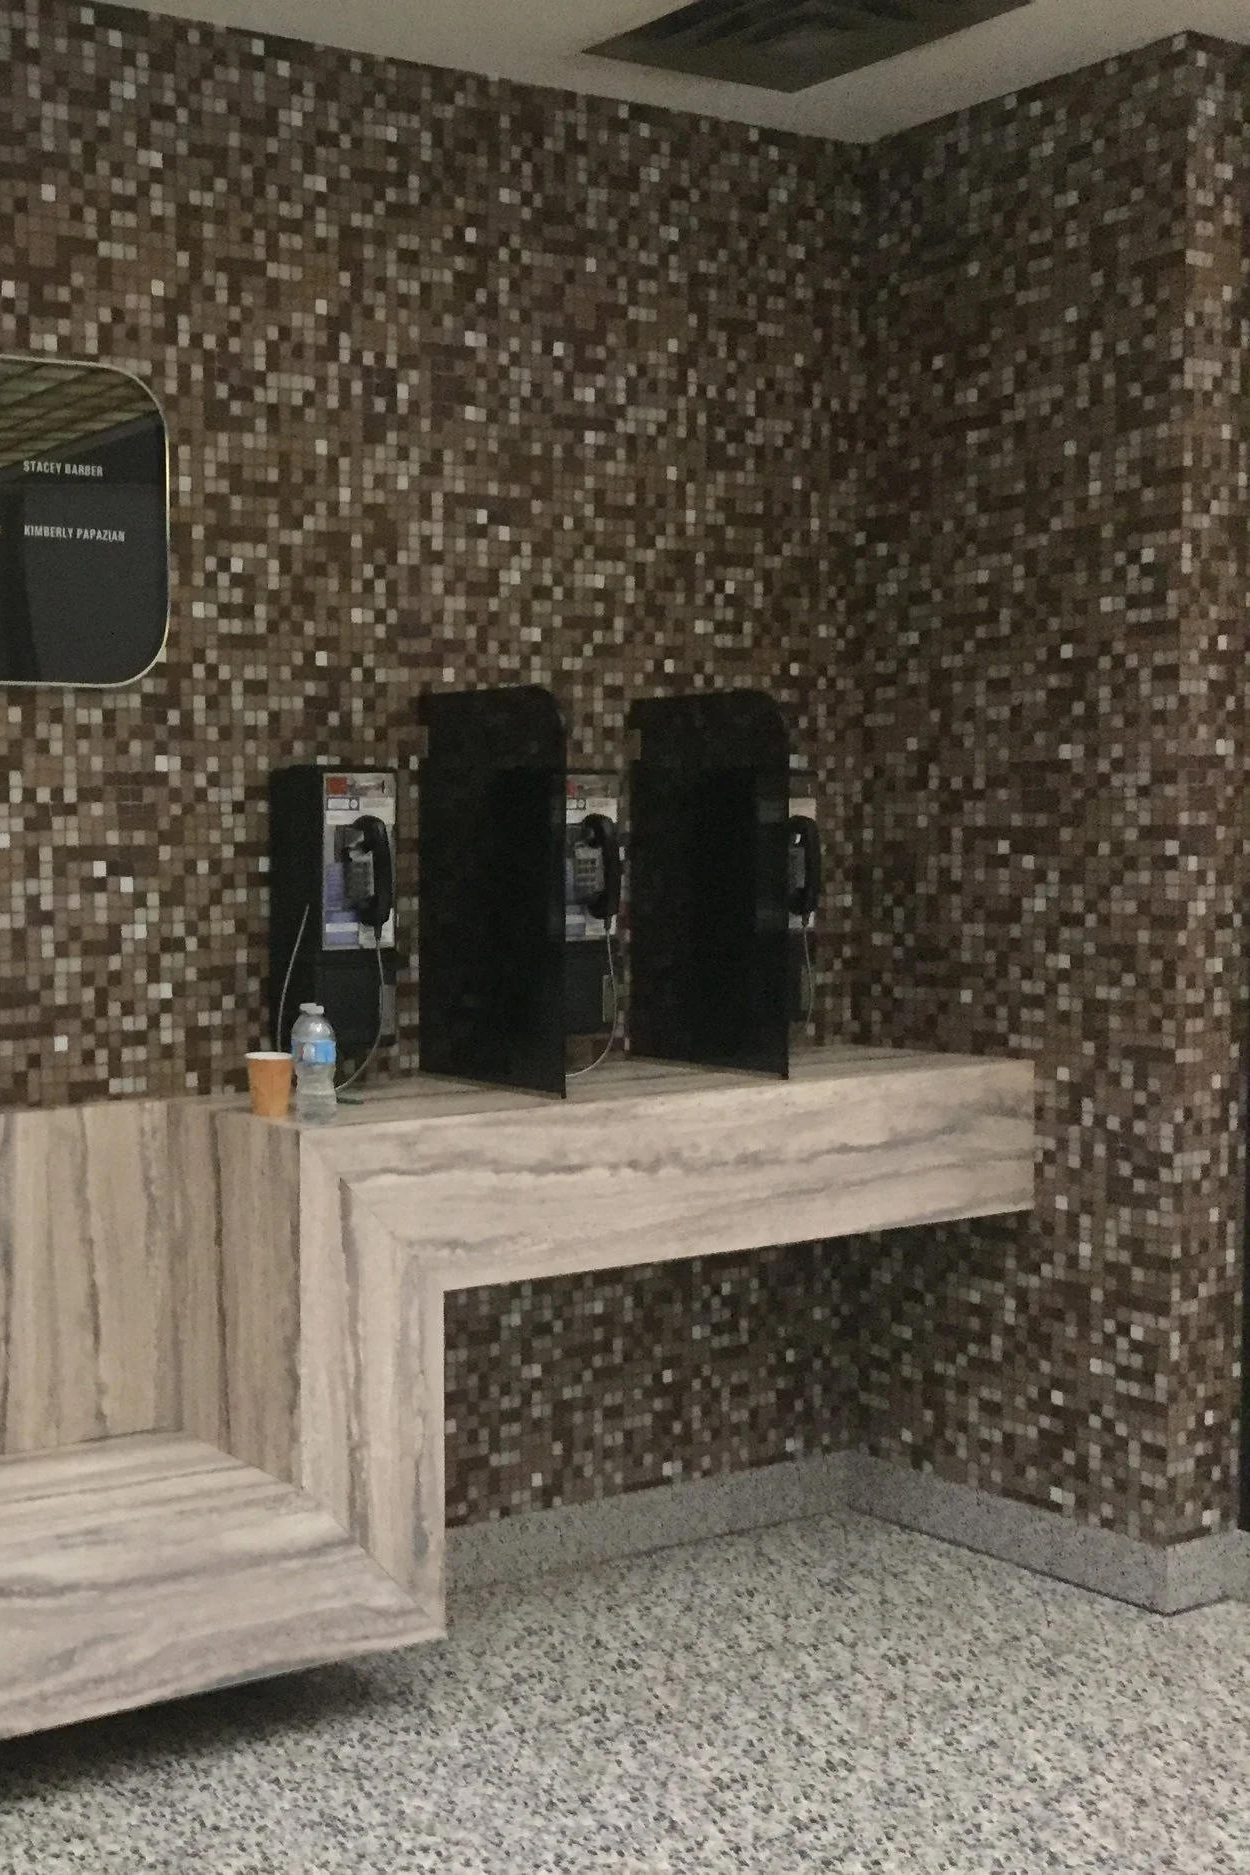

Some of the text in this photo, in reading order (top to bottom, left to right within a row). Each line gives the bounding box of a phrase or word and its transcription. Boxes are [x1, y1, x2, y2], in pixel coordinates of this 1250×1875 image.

[23, 460, 104, 477] STACEY BARBER
[24, 525, 126, 542] KIMBERLY PAPAZIAN
